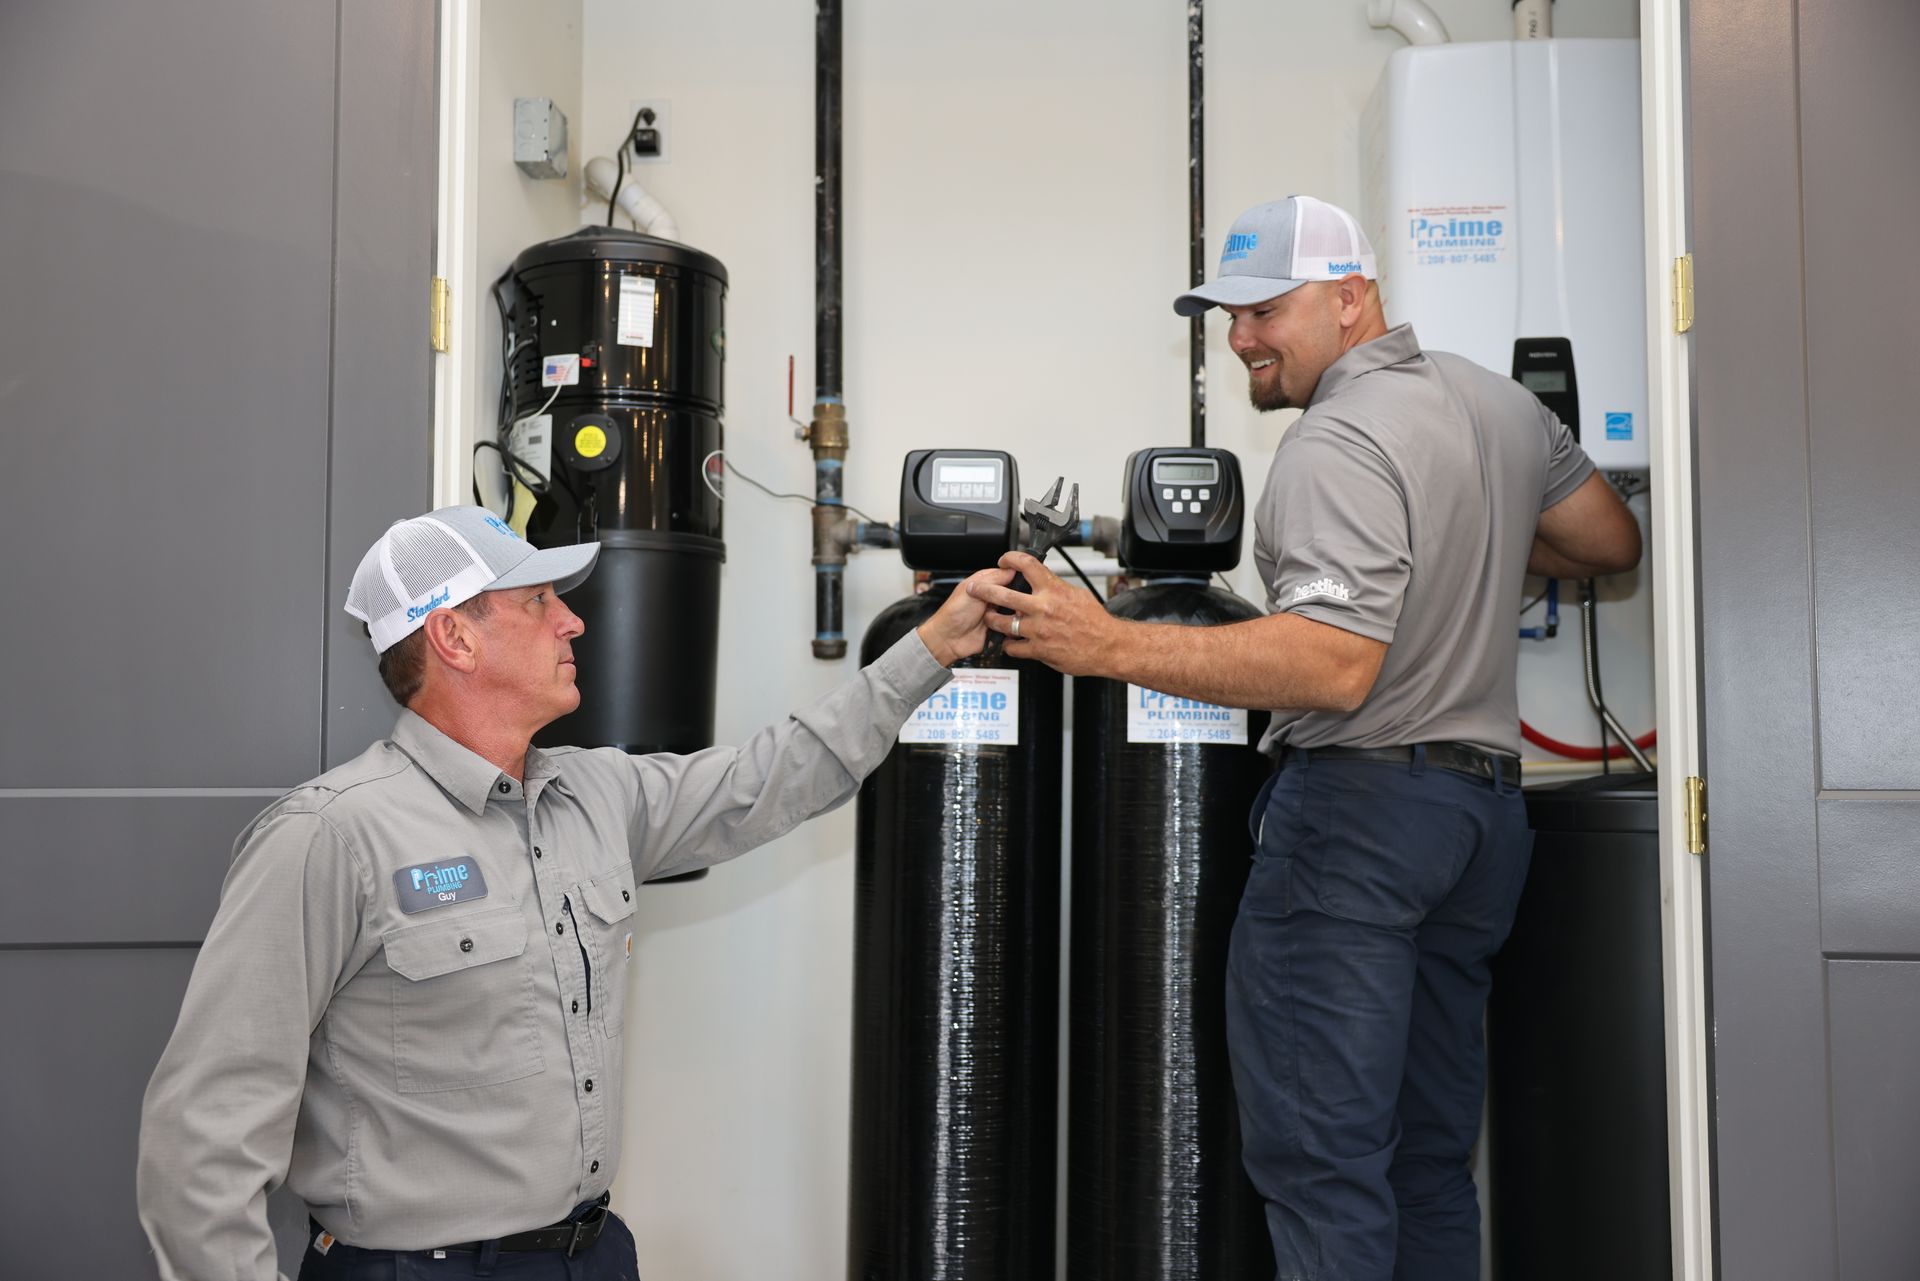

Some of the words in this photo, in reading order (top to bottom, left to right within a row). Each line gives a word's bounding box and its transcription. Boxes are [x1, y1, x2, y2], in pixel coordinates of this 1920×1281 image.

[1410, 217, 1503, 239] Prime
[1417, 238, 1497, 248] PLUMBING
[1295, 578, 1350, 600] heatlink
[407, 586, 450, 622] Standard
[928, 687, 1007, 710] rime
[1147, 710, 1231, 721] PLUMBING
[410, 864, 469, 891] Prime
[427, 881, 464, 895] PLUMBING
[438, 892, 457, 902] Guy
